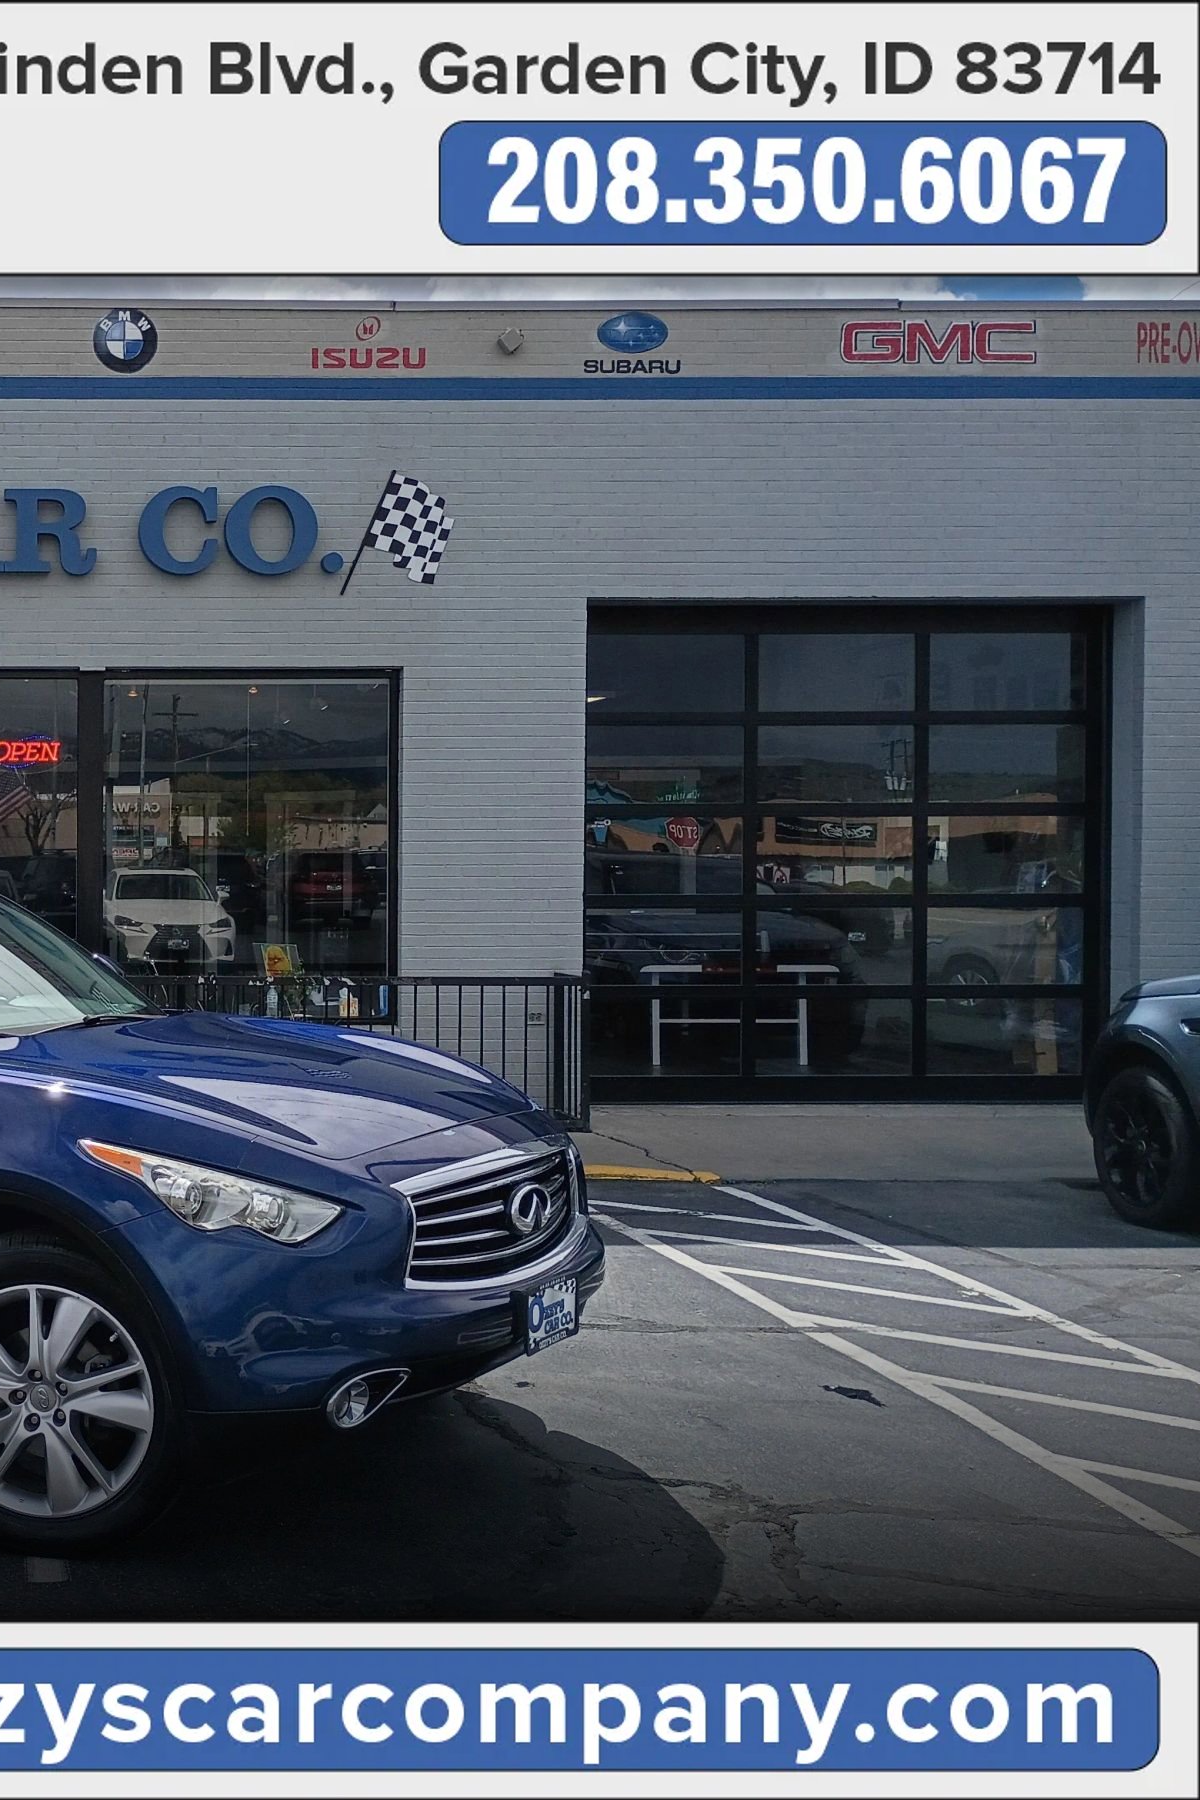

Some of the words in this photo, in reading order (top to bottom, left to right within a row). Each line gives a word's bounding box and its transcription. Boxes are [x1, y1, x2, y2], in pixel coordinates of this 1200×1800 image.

[99, 310, 152, 332] BMW
[841, 320, 1036, 364] GMC
[311, 347, 427, 369] ISUZU
[583, 359, 681, 375] SUBARU
[138, 484, 344, 576] CO.
[544, 1316, 560, 1334] CAR
